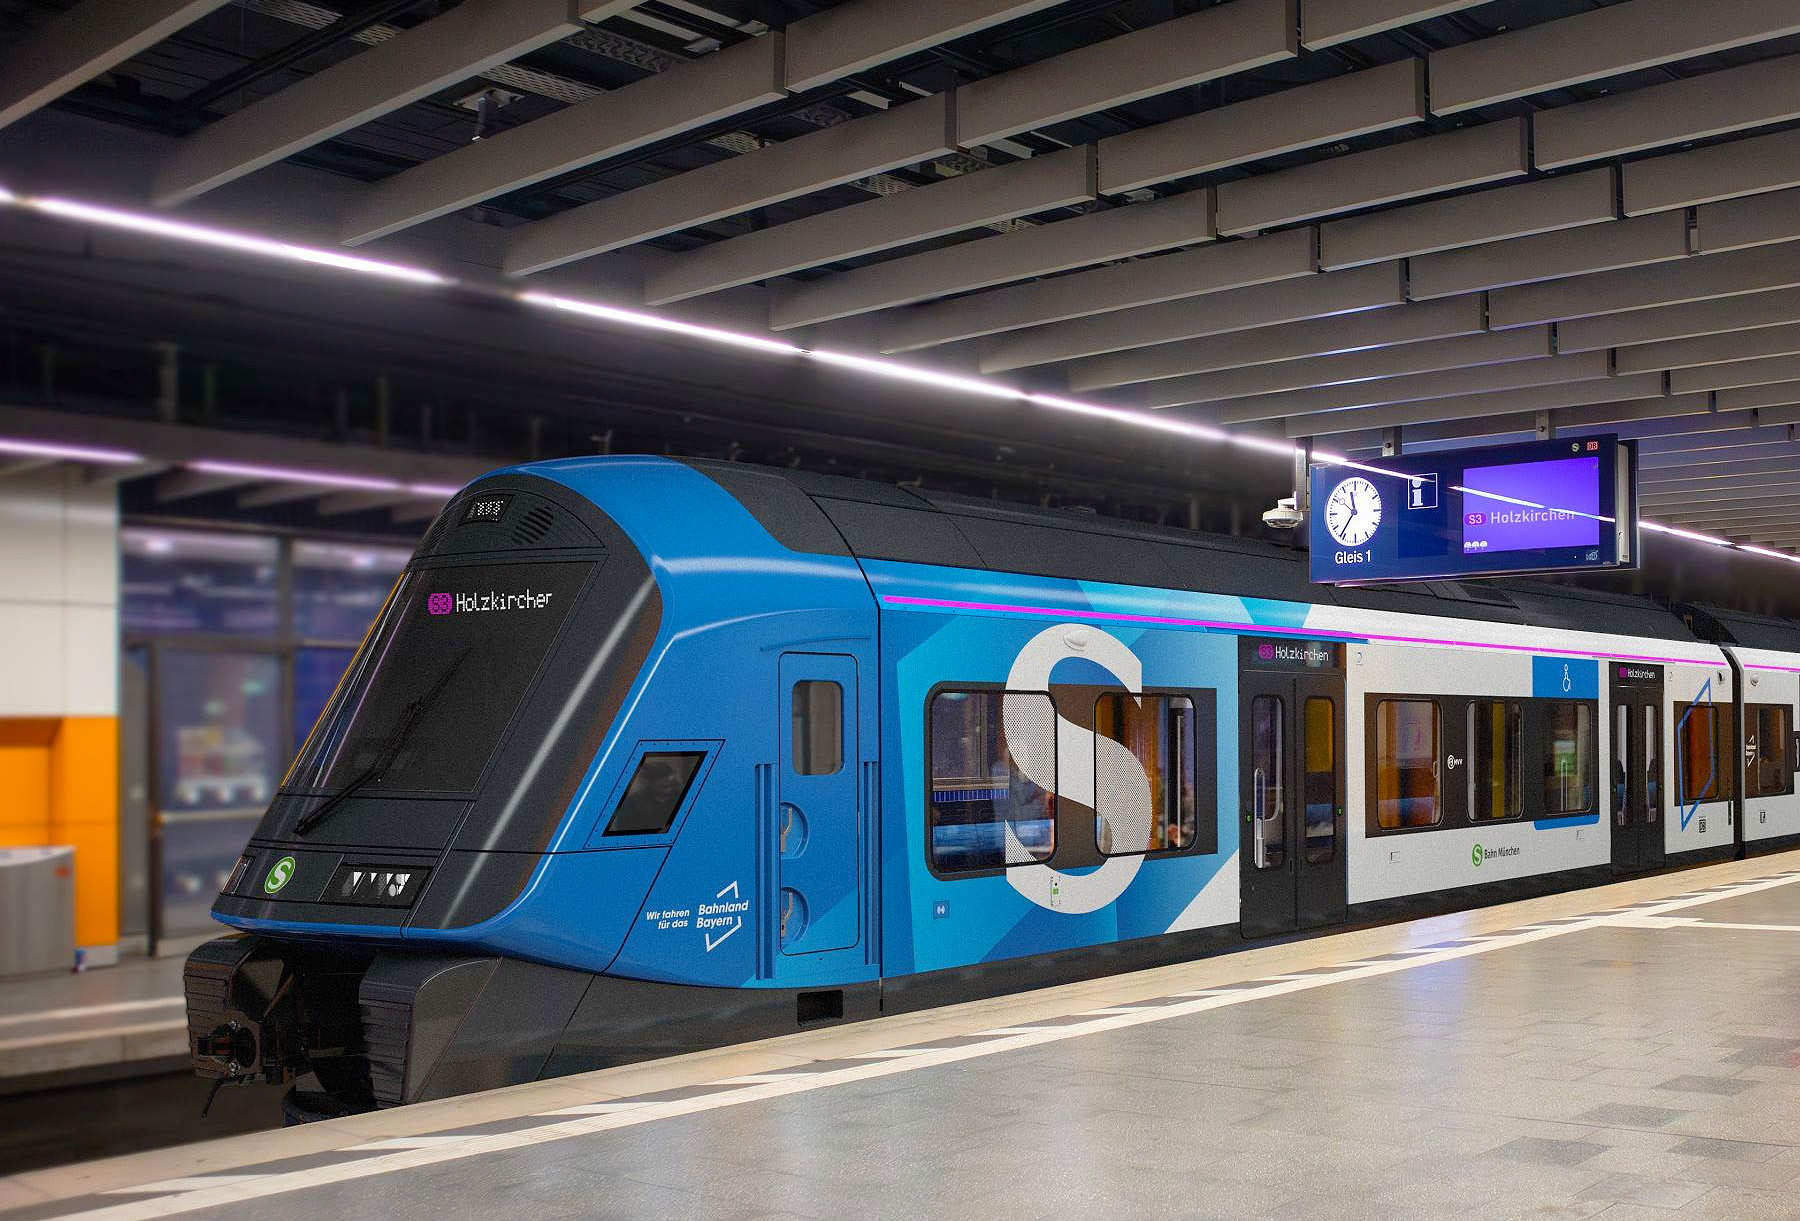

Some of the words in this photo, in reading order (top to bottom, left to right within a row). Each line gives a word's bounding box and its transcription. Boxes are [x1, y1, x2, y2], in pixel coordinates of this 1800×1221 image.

[1587, 441, 1598, 450] DB
[1468, 514, 1483, 525] S3
[1490, 509, 1575, 524] Holzkirchen
[1335, 550, 1364, 564] Gleis
[1366, 549, 1371, 563] 1
[1275, 645, 1329, 661] Holzkirchen
[1473, 845, 1482, 865] S
[1484, 849, 1498, 859] Bahn
[1498, 846, 1520, 857] München
[267, 861, 292, 889] S
[646, 911, 660, 920] Wir
[662, 909, 690, 919] fahren
[698, 900, 749, 915] Bahnland
[658, 920, 669, 930] für
[672, 919, 688, 928] das
[696, 916, 733, 929] Bayern
